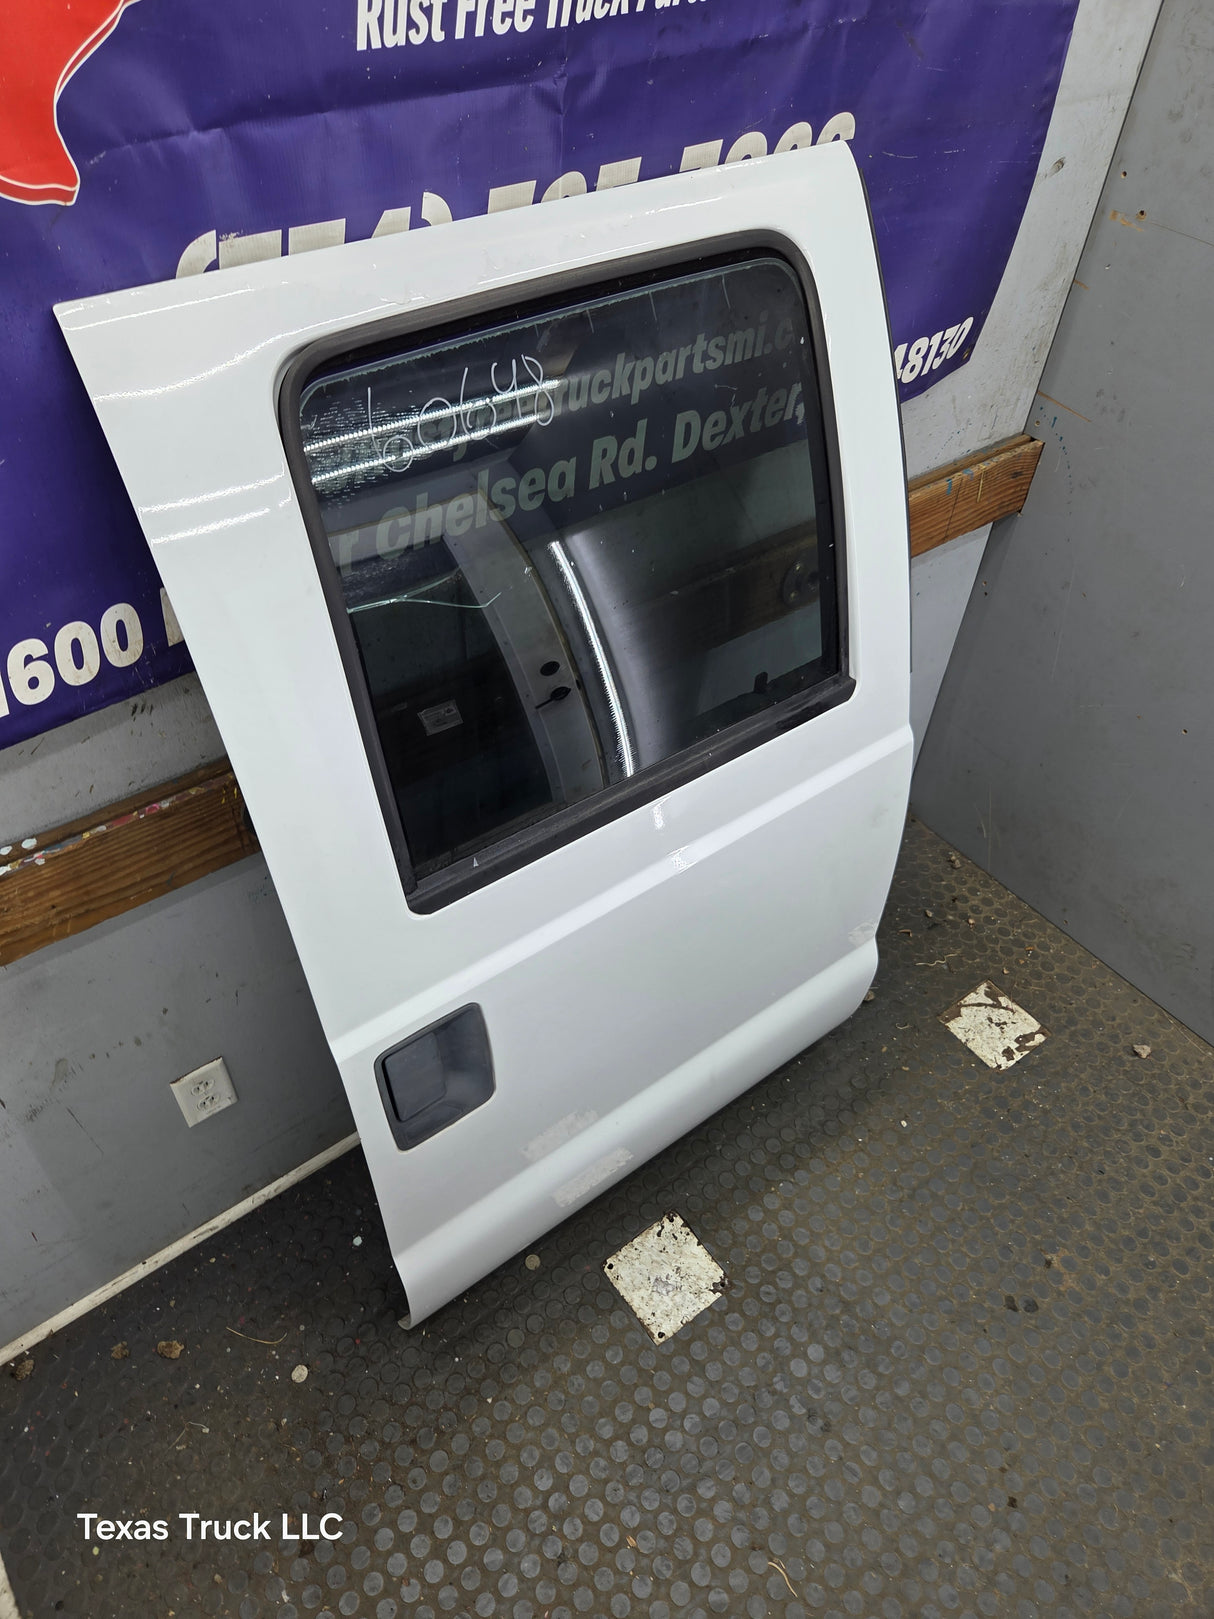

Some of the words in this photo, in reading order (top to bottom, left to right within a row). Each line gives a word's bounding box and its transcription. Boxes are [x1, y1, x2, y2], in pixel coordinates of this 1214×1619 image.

[356, 0, 446, 51] Rust
[0, 602, 144, 718] 600
[375, 456, 577, 561] Chelsea
[588, 418, 658, 490] Rd.
